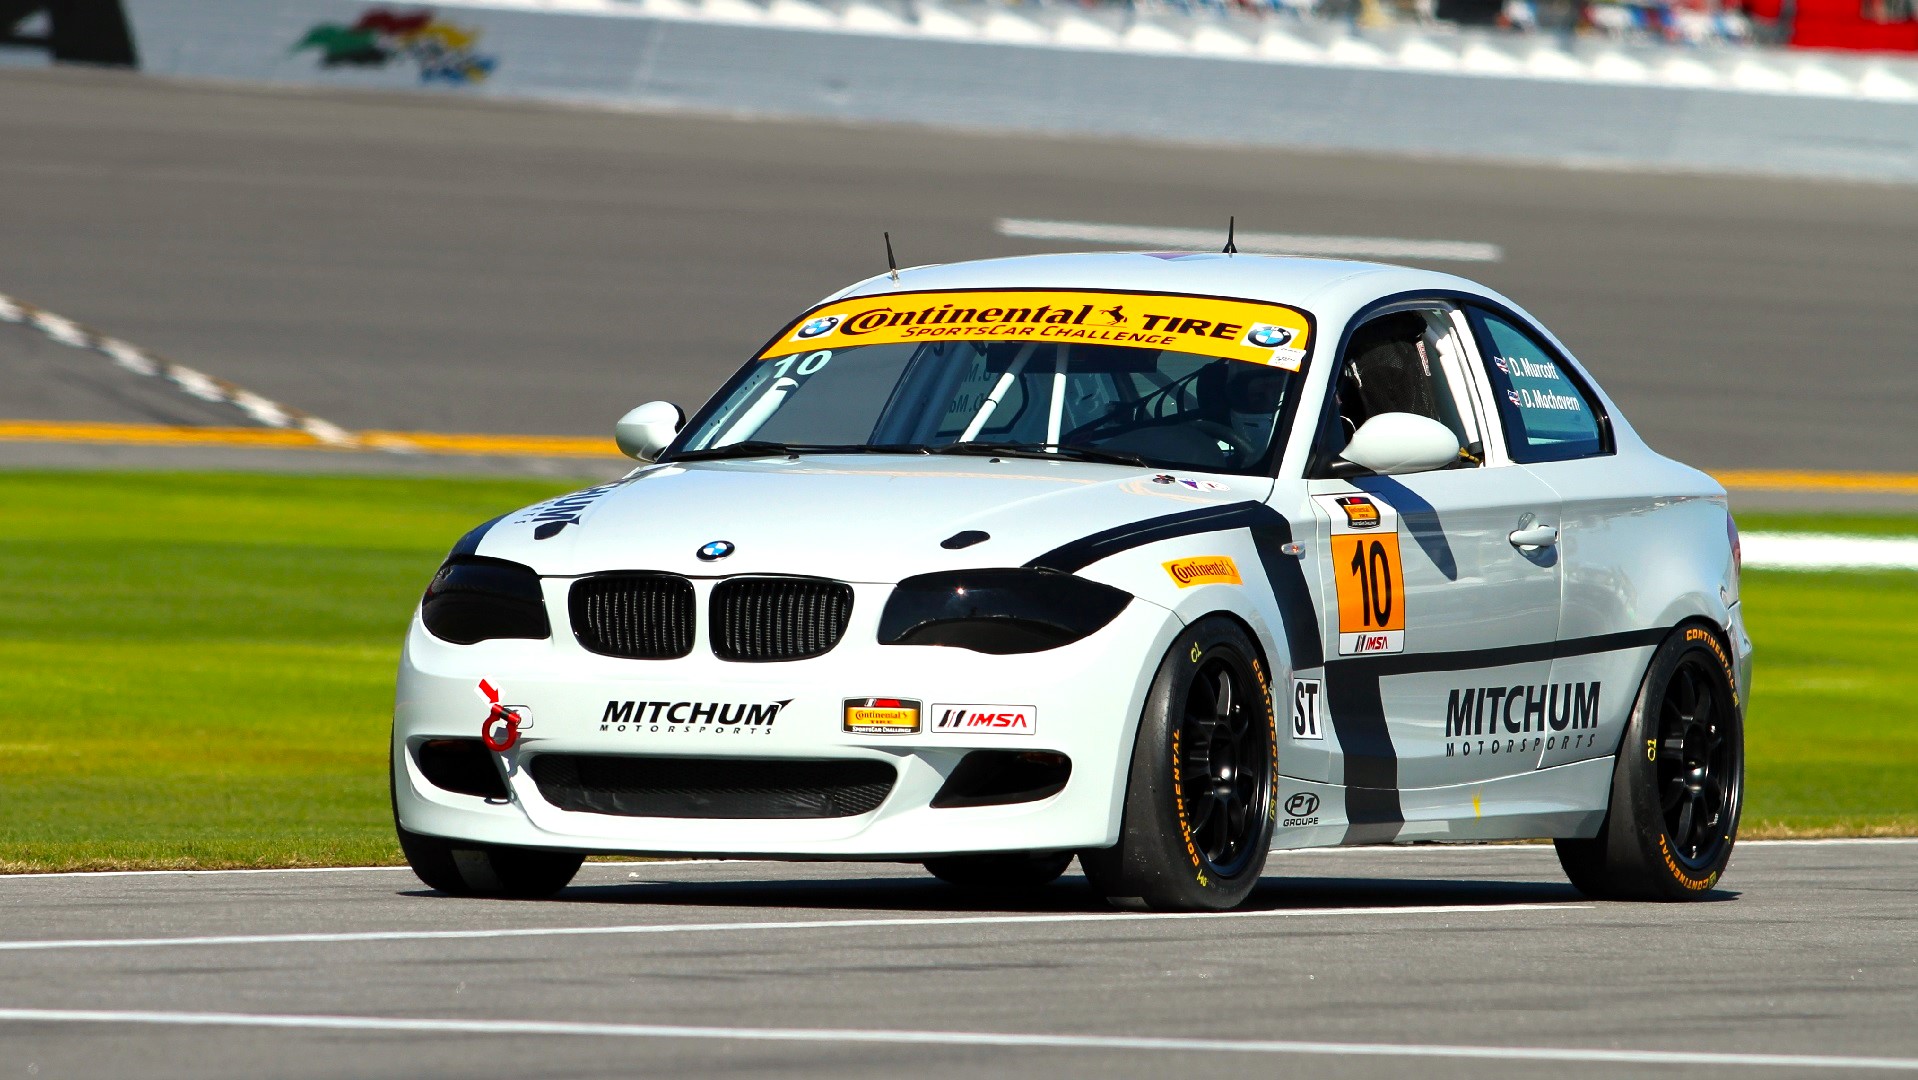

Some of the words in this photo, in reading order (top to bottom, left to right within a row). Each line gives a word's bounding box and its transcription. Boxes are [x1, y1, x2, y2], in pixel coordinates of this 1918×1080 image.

[840, 304, 1094, 335] Continental
[1142, 313, 1243, 341] TIRE
[773, 350, 833, 379] 10
[1510, 357, 1524, 377] D.
[1523, 358, 1560, 380] Murcott
[1524, 389, 1535, 408] D.
[1533, 390, 1581, 411] Machavern
[1171, 560, 1229, 584] Continental
[1351, 540, 1392, 627] 10
[1365, 636, 1389, 651] IMSA
[1686, 628, 1734, 690] CONTINENTAL
[602, 700, 780, 726] MITCHUM
[855, 711, 901, 721] Continental
[967, 713, 1028, 728] IMSA
[1294, 681, 1318, 736] ST
[1445, 681, 1601, 738] MITCHUM
[599, 724, 772, 735] MOTORSPORTS
[1252, 658, 1279, 797] CONTINENTAL
[1446, 733, 1596, 758] MOTORSPORTS
[1172, 729, 1200, 867] CONTINENTAL
[1283, 817, 1319, 827] GROUPE
[1659, 833, 1709, 890] CONTINENTAL
